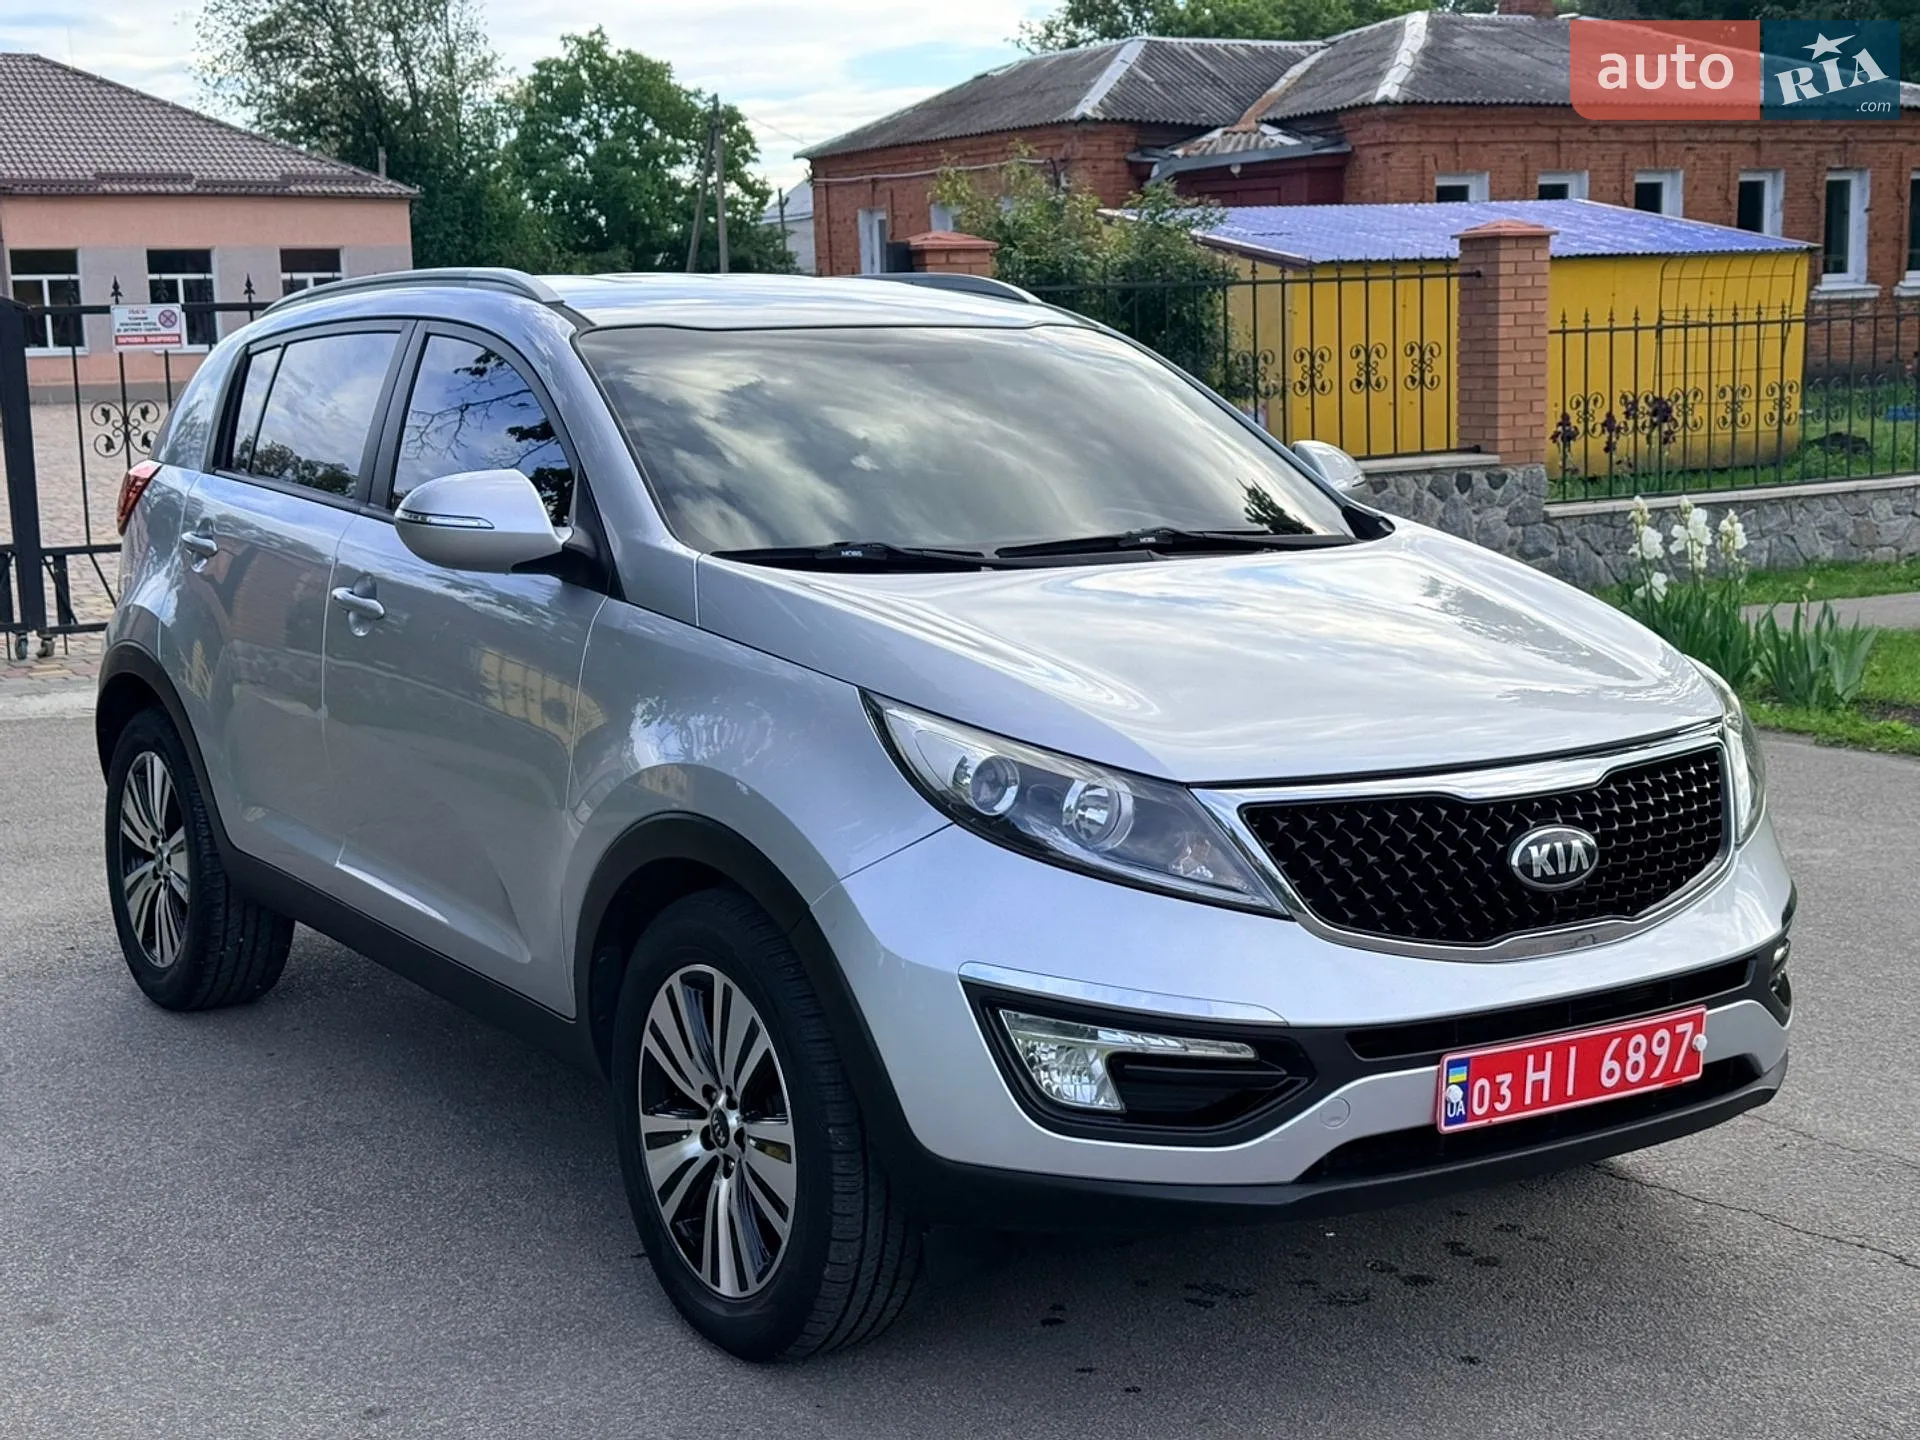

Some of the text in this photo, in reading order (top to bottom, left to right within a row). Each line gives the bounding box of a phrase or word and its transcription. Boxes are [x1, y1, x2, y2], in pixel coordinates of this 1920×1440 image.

[1528, 839, 1589, 878] KIA
[1599, 1021, 1695, 1088] 6897
[1447, 1100, 1466, 1118] UA
